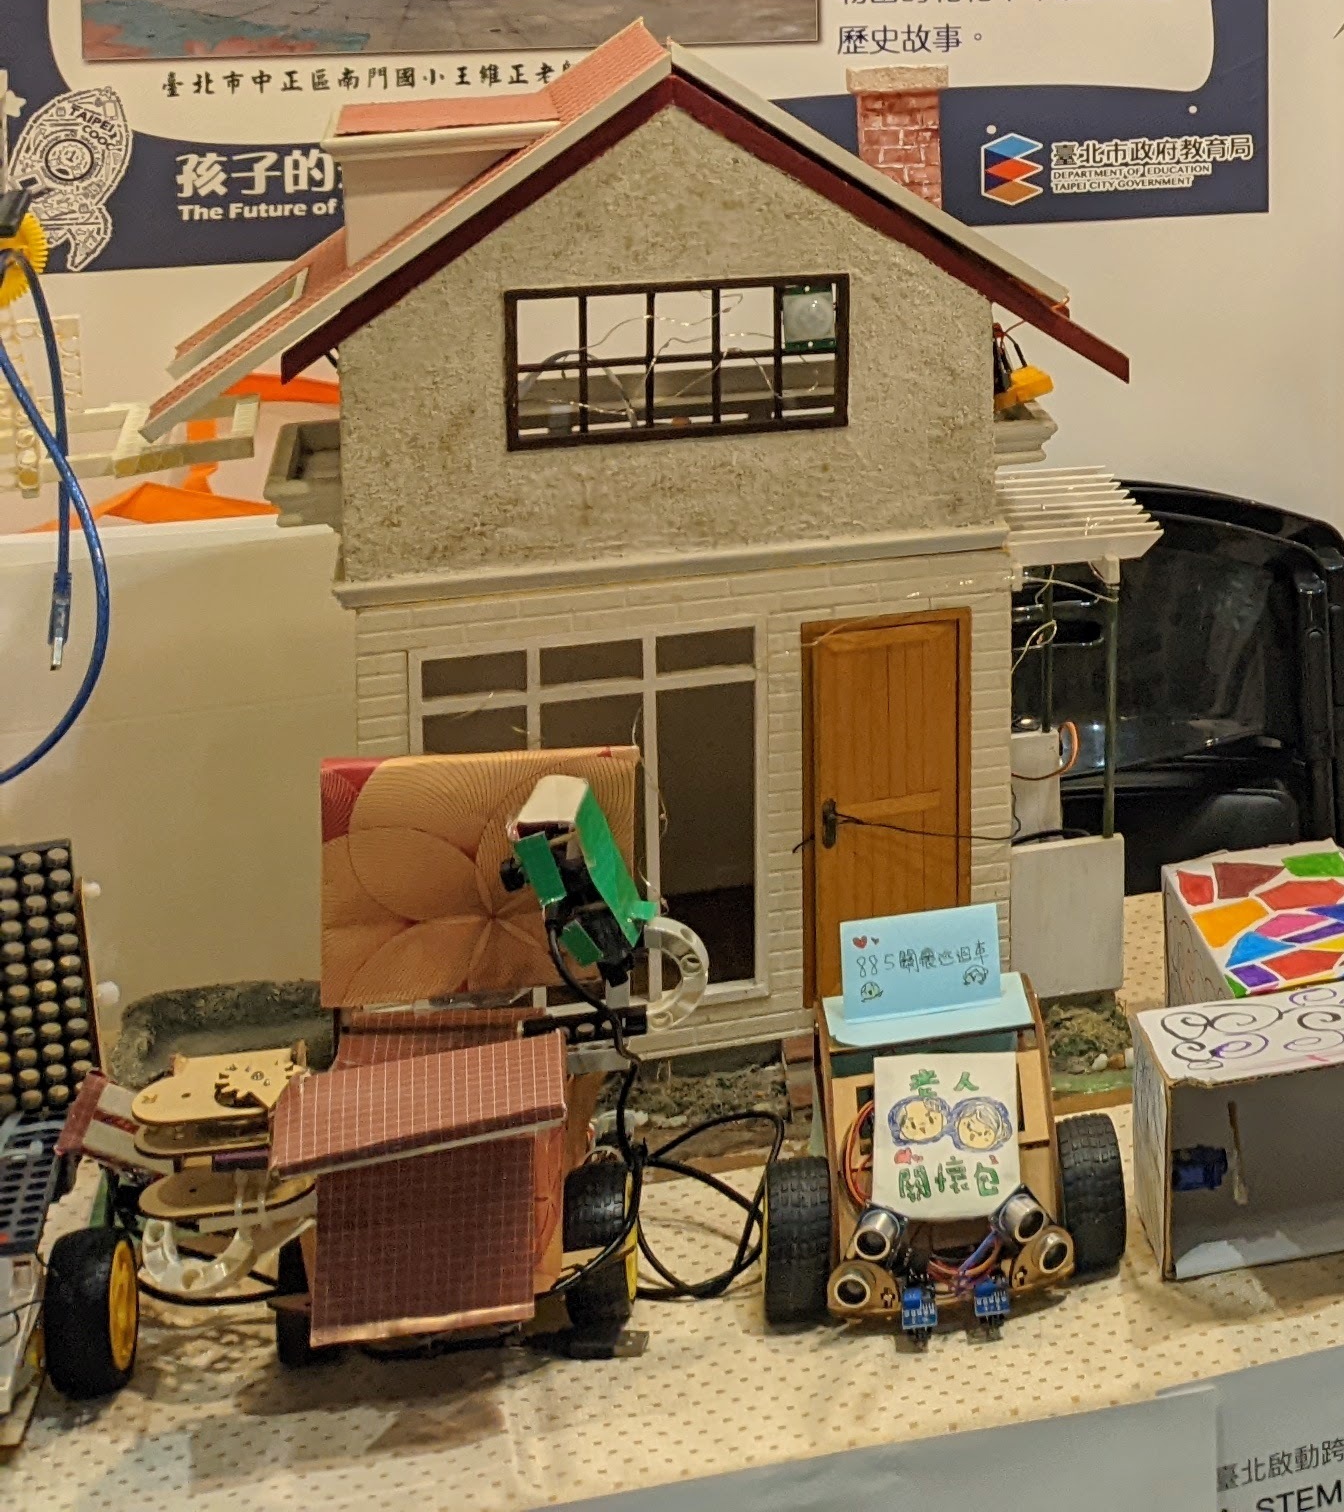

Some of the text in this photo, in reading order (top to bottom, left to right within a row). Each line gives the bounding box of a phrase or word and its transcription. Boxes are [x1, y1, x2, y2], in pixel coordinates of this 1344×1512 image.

[836, 24, 985, 56] 歷史故事。
[161, 61, 573, 99] 臺北市中正區南門國小王維正老
[69, 103, 117, 135] TAIPEI
[1053, 137, 1252, 168] 臺北市政府教育局
[175, 150, 343, 199] 孩子的
[1053, 164, 1211, 180] DEPARTMENT OF EDUCATION
[1054, 177, 1192, 192] TAIPEI CITY GOVERNMENT
[178, 199, 339, 222] The Future of
[898, 1155, 1000, 1202] 關懷包
